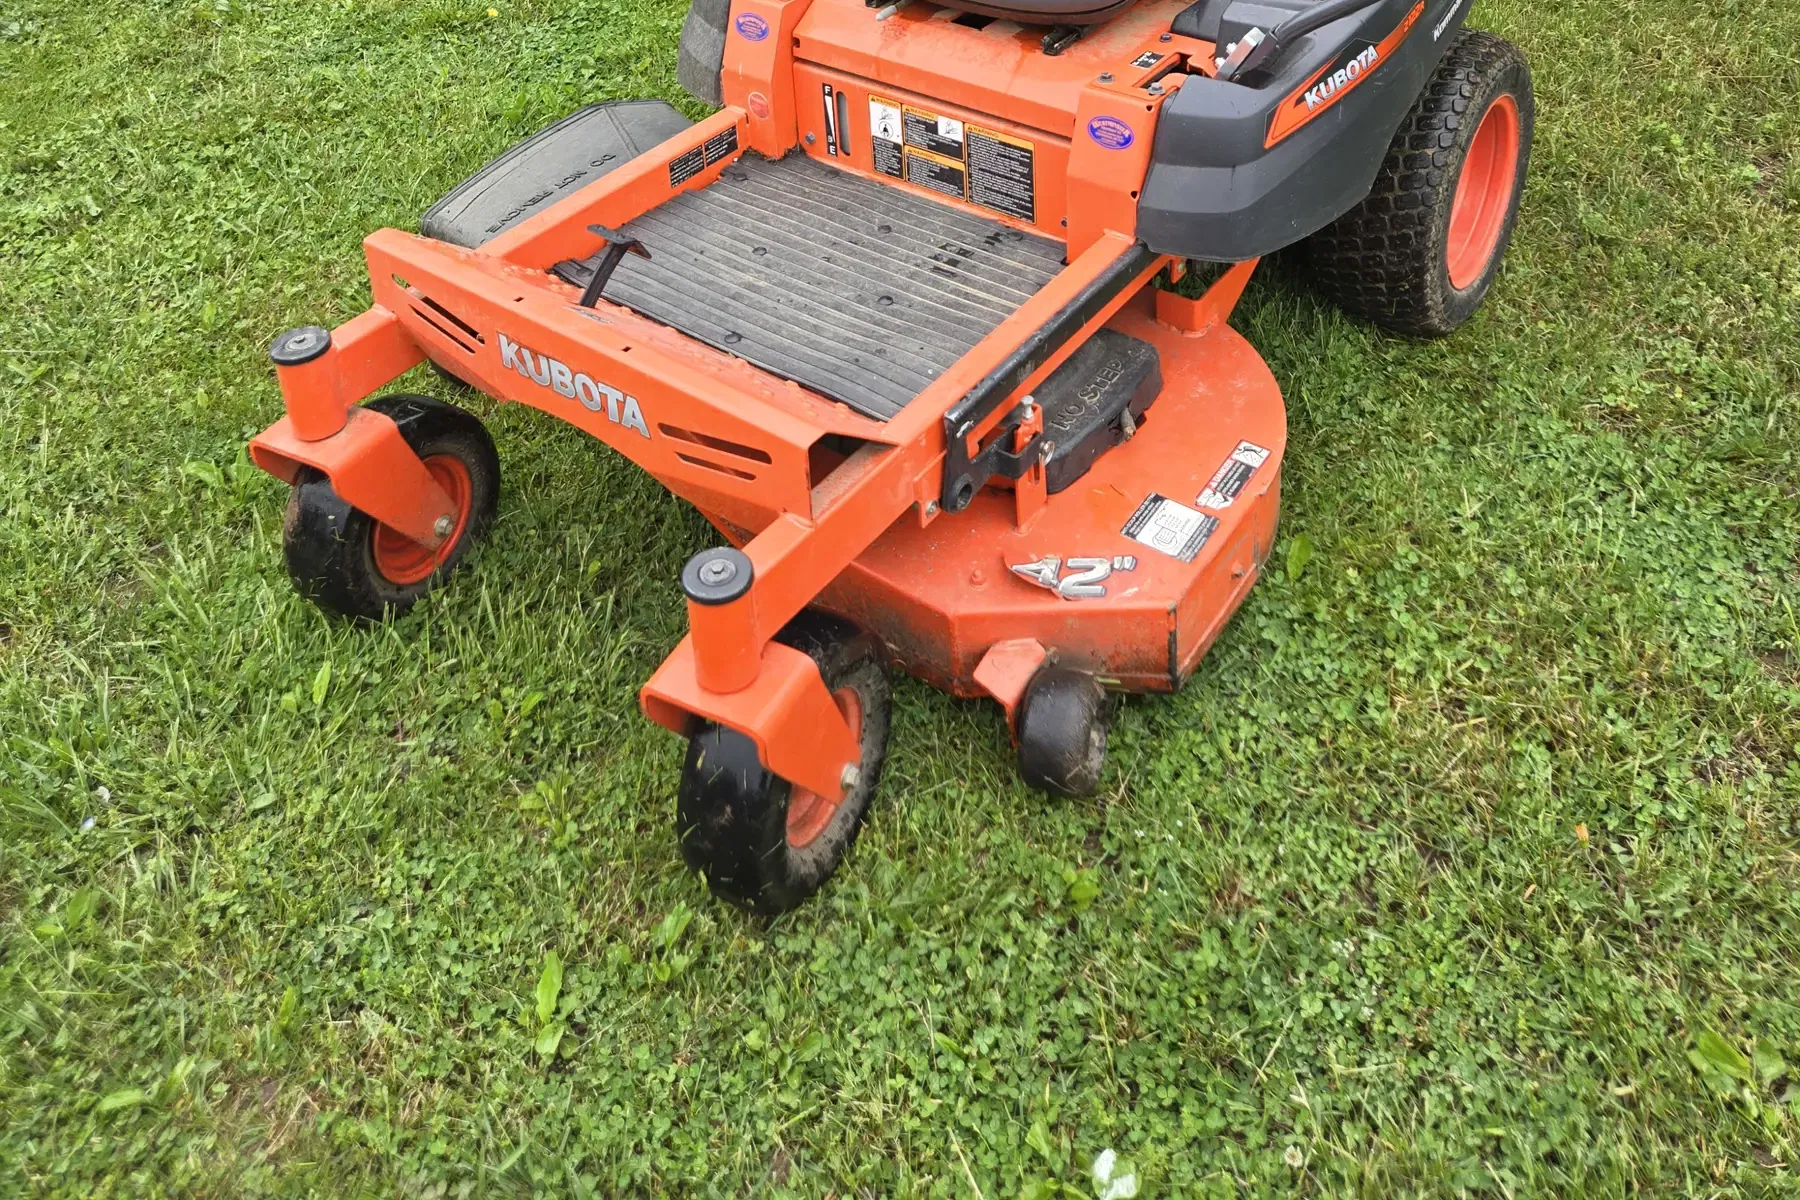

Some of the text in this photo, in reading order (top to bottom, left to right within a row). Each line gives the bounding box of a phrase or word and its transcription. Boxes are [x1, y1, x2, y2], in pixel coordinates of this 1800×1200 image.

[824, 85, 831, 94] F
[1304, 44, 1379, 111] KUBOTA
[973, 126, 999, 138] WARNING
[829, 145, 836, 155] E
[497, 331, 651, 439] KUBOTA
[1050, 358, 1125, 431] NO STEP
[1211, 458, 1235, 482] DANGER
